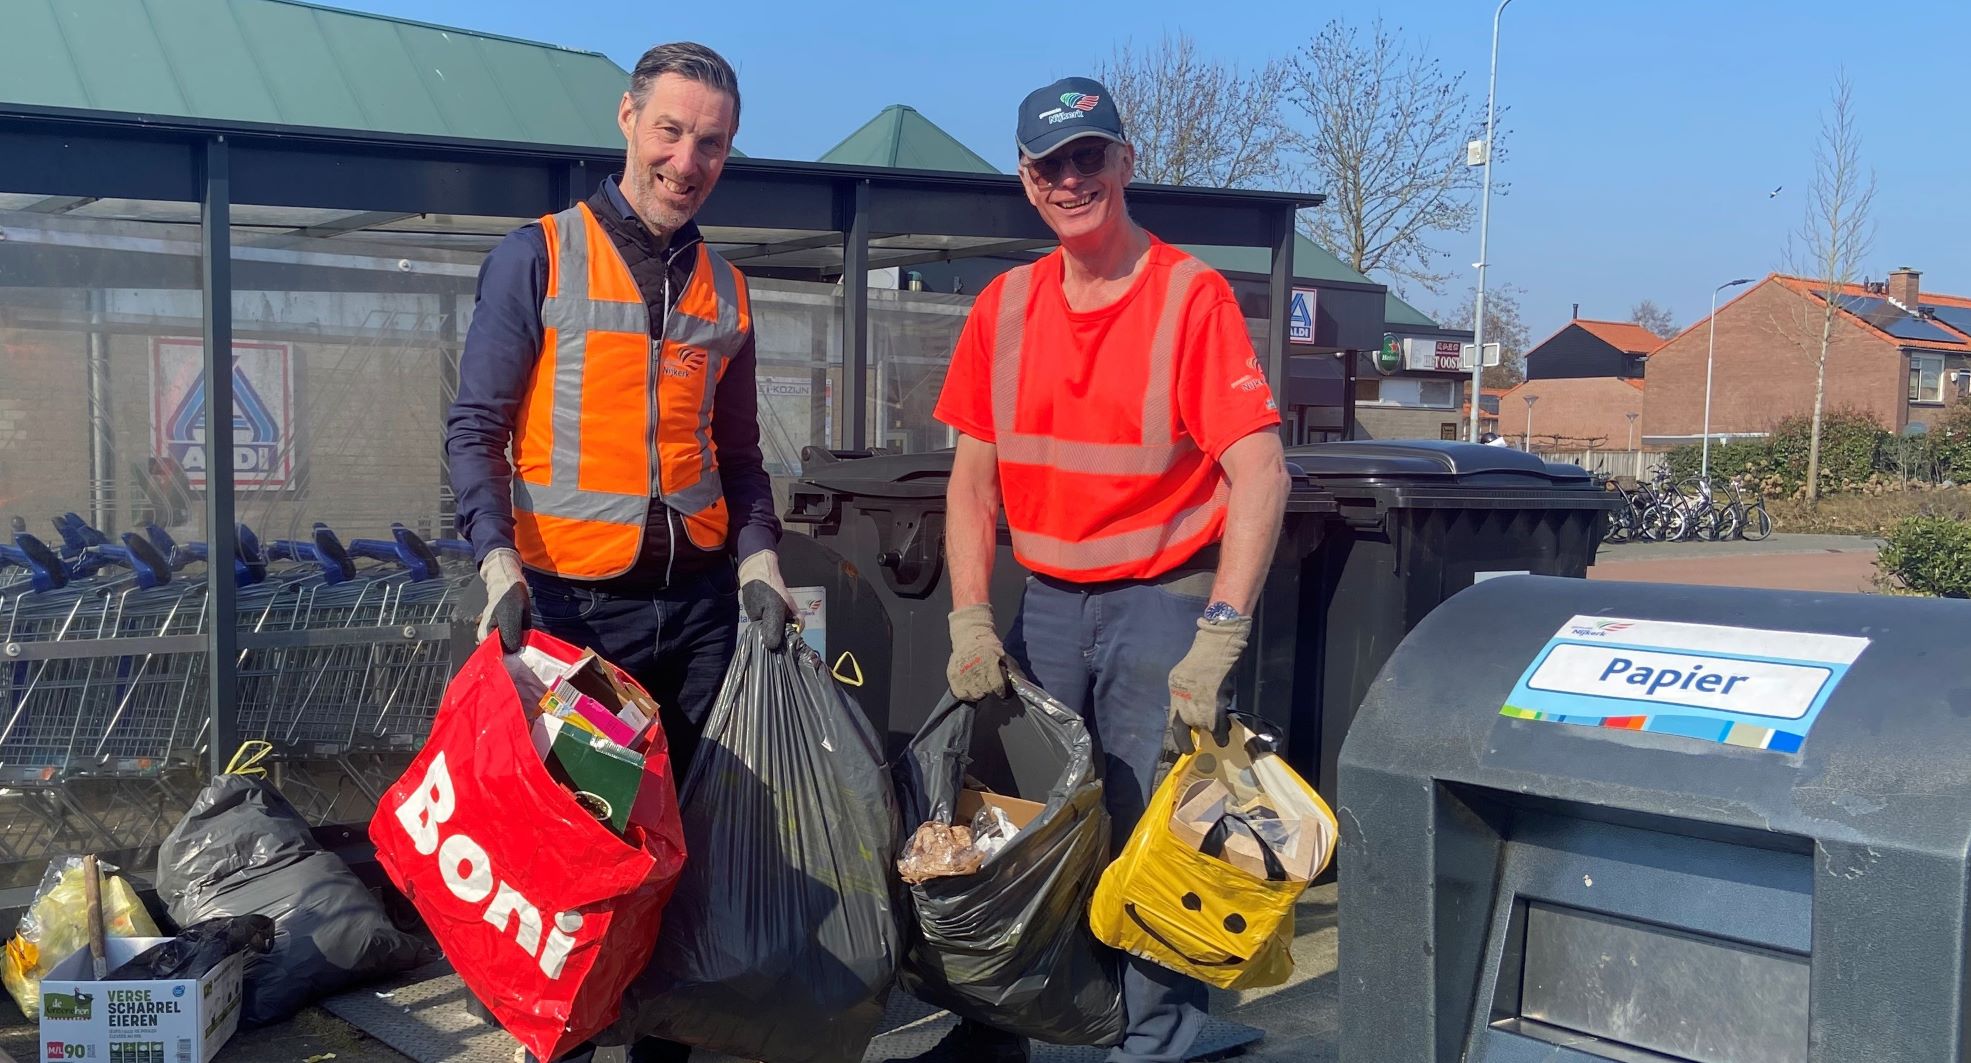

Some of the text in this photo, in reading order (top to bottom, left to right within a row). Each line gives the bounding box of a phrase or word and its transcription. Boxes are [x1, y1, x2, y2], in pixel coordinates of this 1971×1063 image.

[663, 366, 689, 378] Nijkerk
[182, 446, 269, 470] ADI
[1572, 628, 1606, 637] Nijkerk
[1599, 657, 1749, 695] Papier
[395, 750, 583, 980] Boni
[107, 990, 152, 1002] VERSE
[108, 1001, 181, 1014] SCHARREL
[108, 1014, 158, 1027] EIEREN
[64, 1044, 86, 1058] 90
